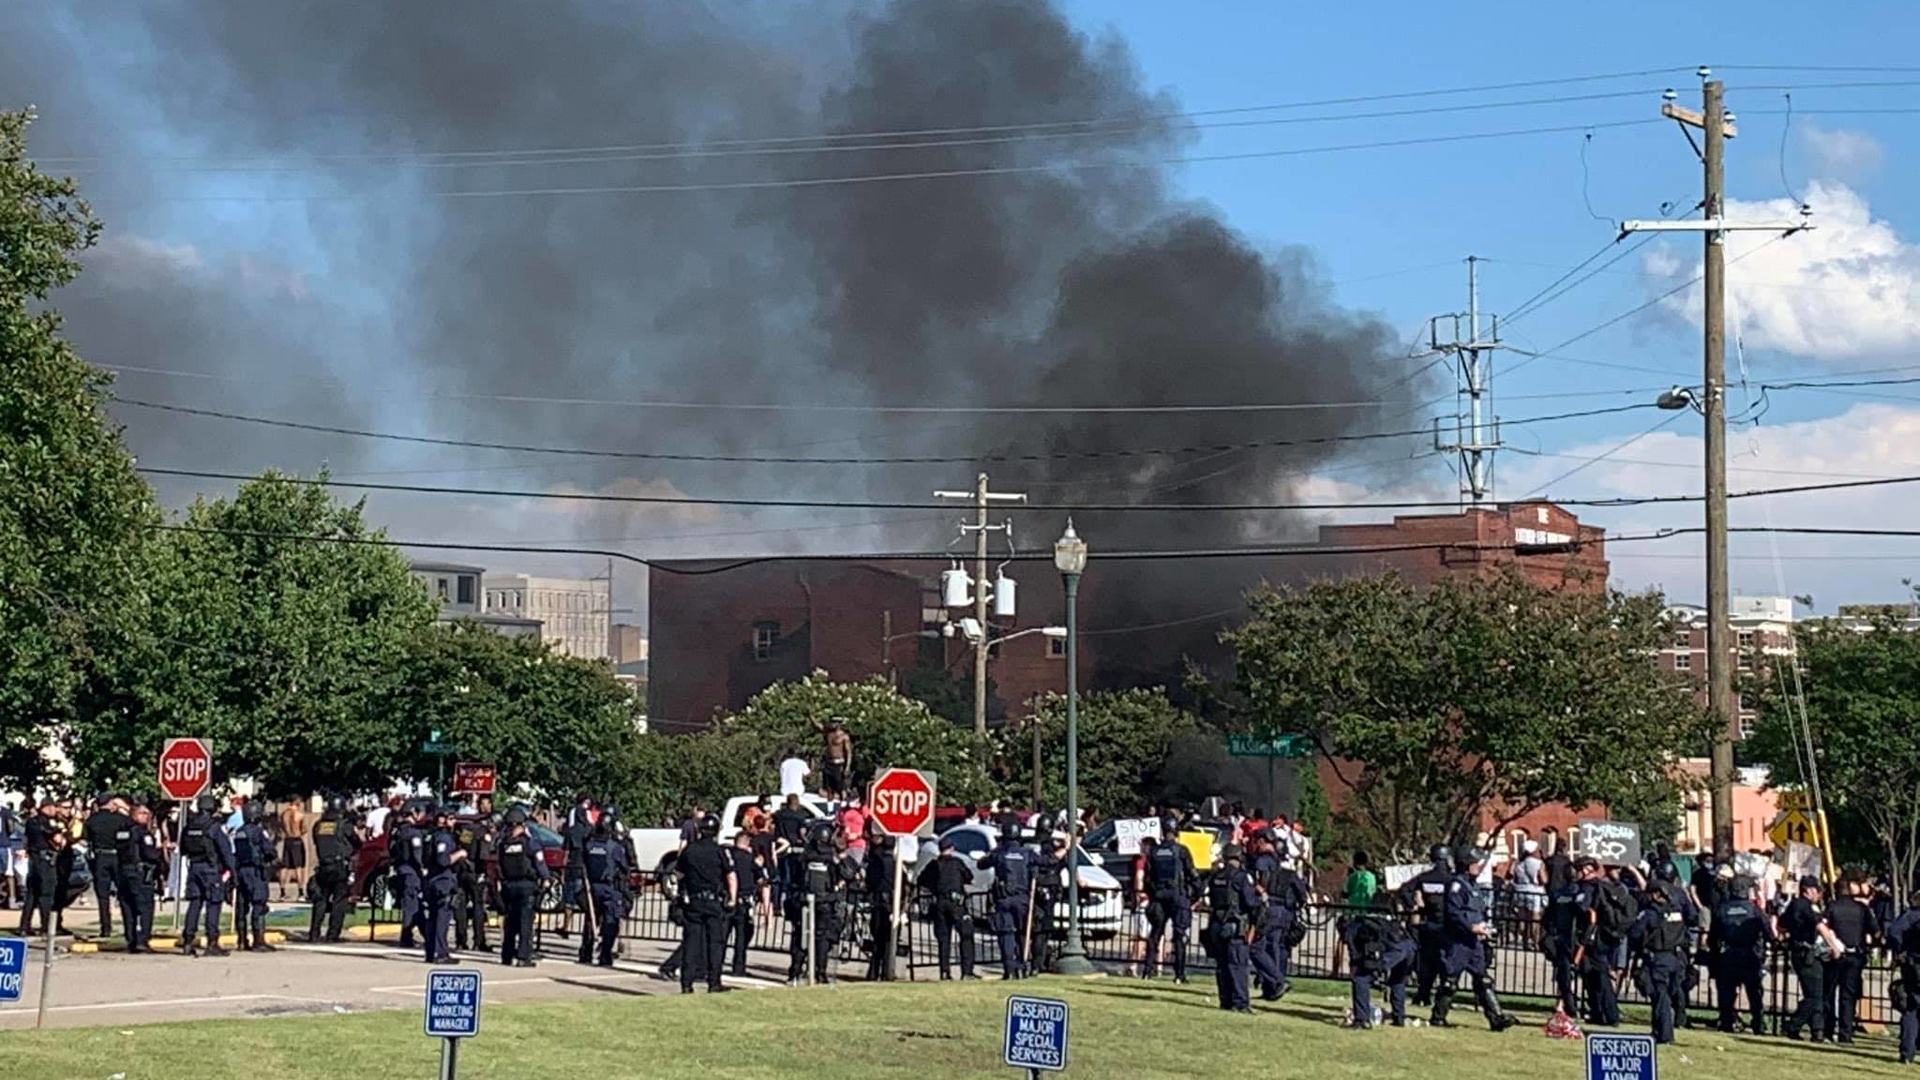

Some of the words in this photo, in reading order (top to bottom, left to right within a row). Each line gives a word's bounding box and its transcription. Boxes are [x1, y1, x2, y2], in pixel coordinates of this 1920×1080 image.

[165, 758, 206, 781] STOP
[876, 789, 928, 816] STOP
[433, 976, 476, 991] RESERVED
[463, 992, 470, 1004] &
[431, 1004, 474, 1017] MARKETING
[1013, 1002, 1064, 1021] RESERVED
[434, 1018, 469, 1030] MANAGER
[1019, 1018, 1055, 1034] MAJOR
[1015, 1032, 1057, 1050] SPECIAL
[1592, 1039, 1650, 1057] RESERVED
[1011, 1046, 1060, 1065] SERVICES
[1601, 1056, 1642, 1072] MAJOR
